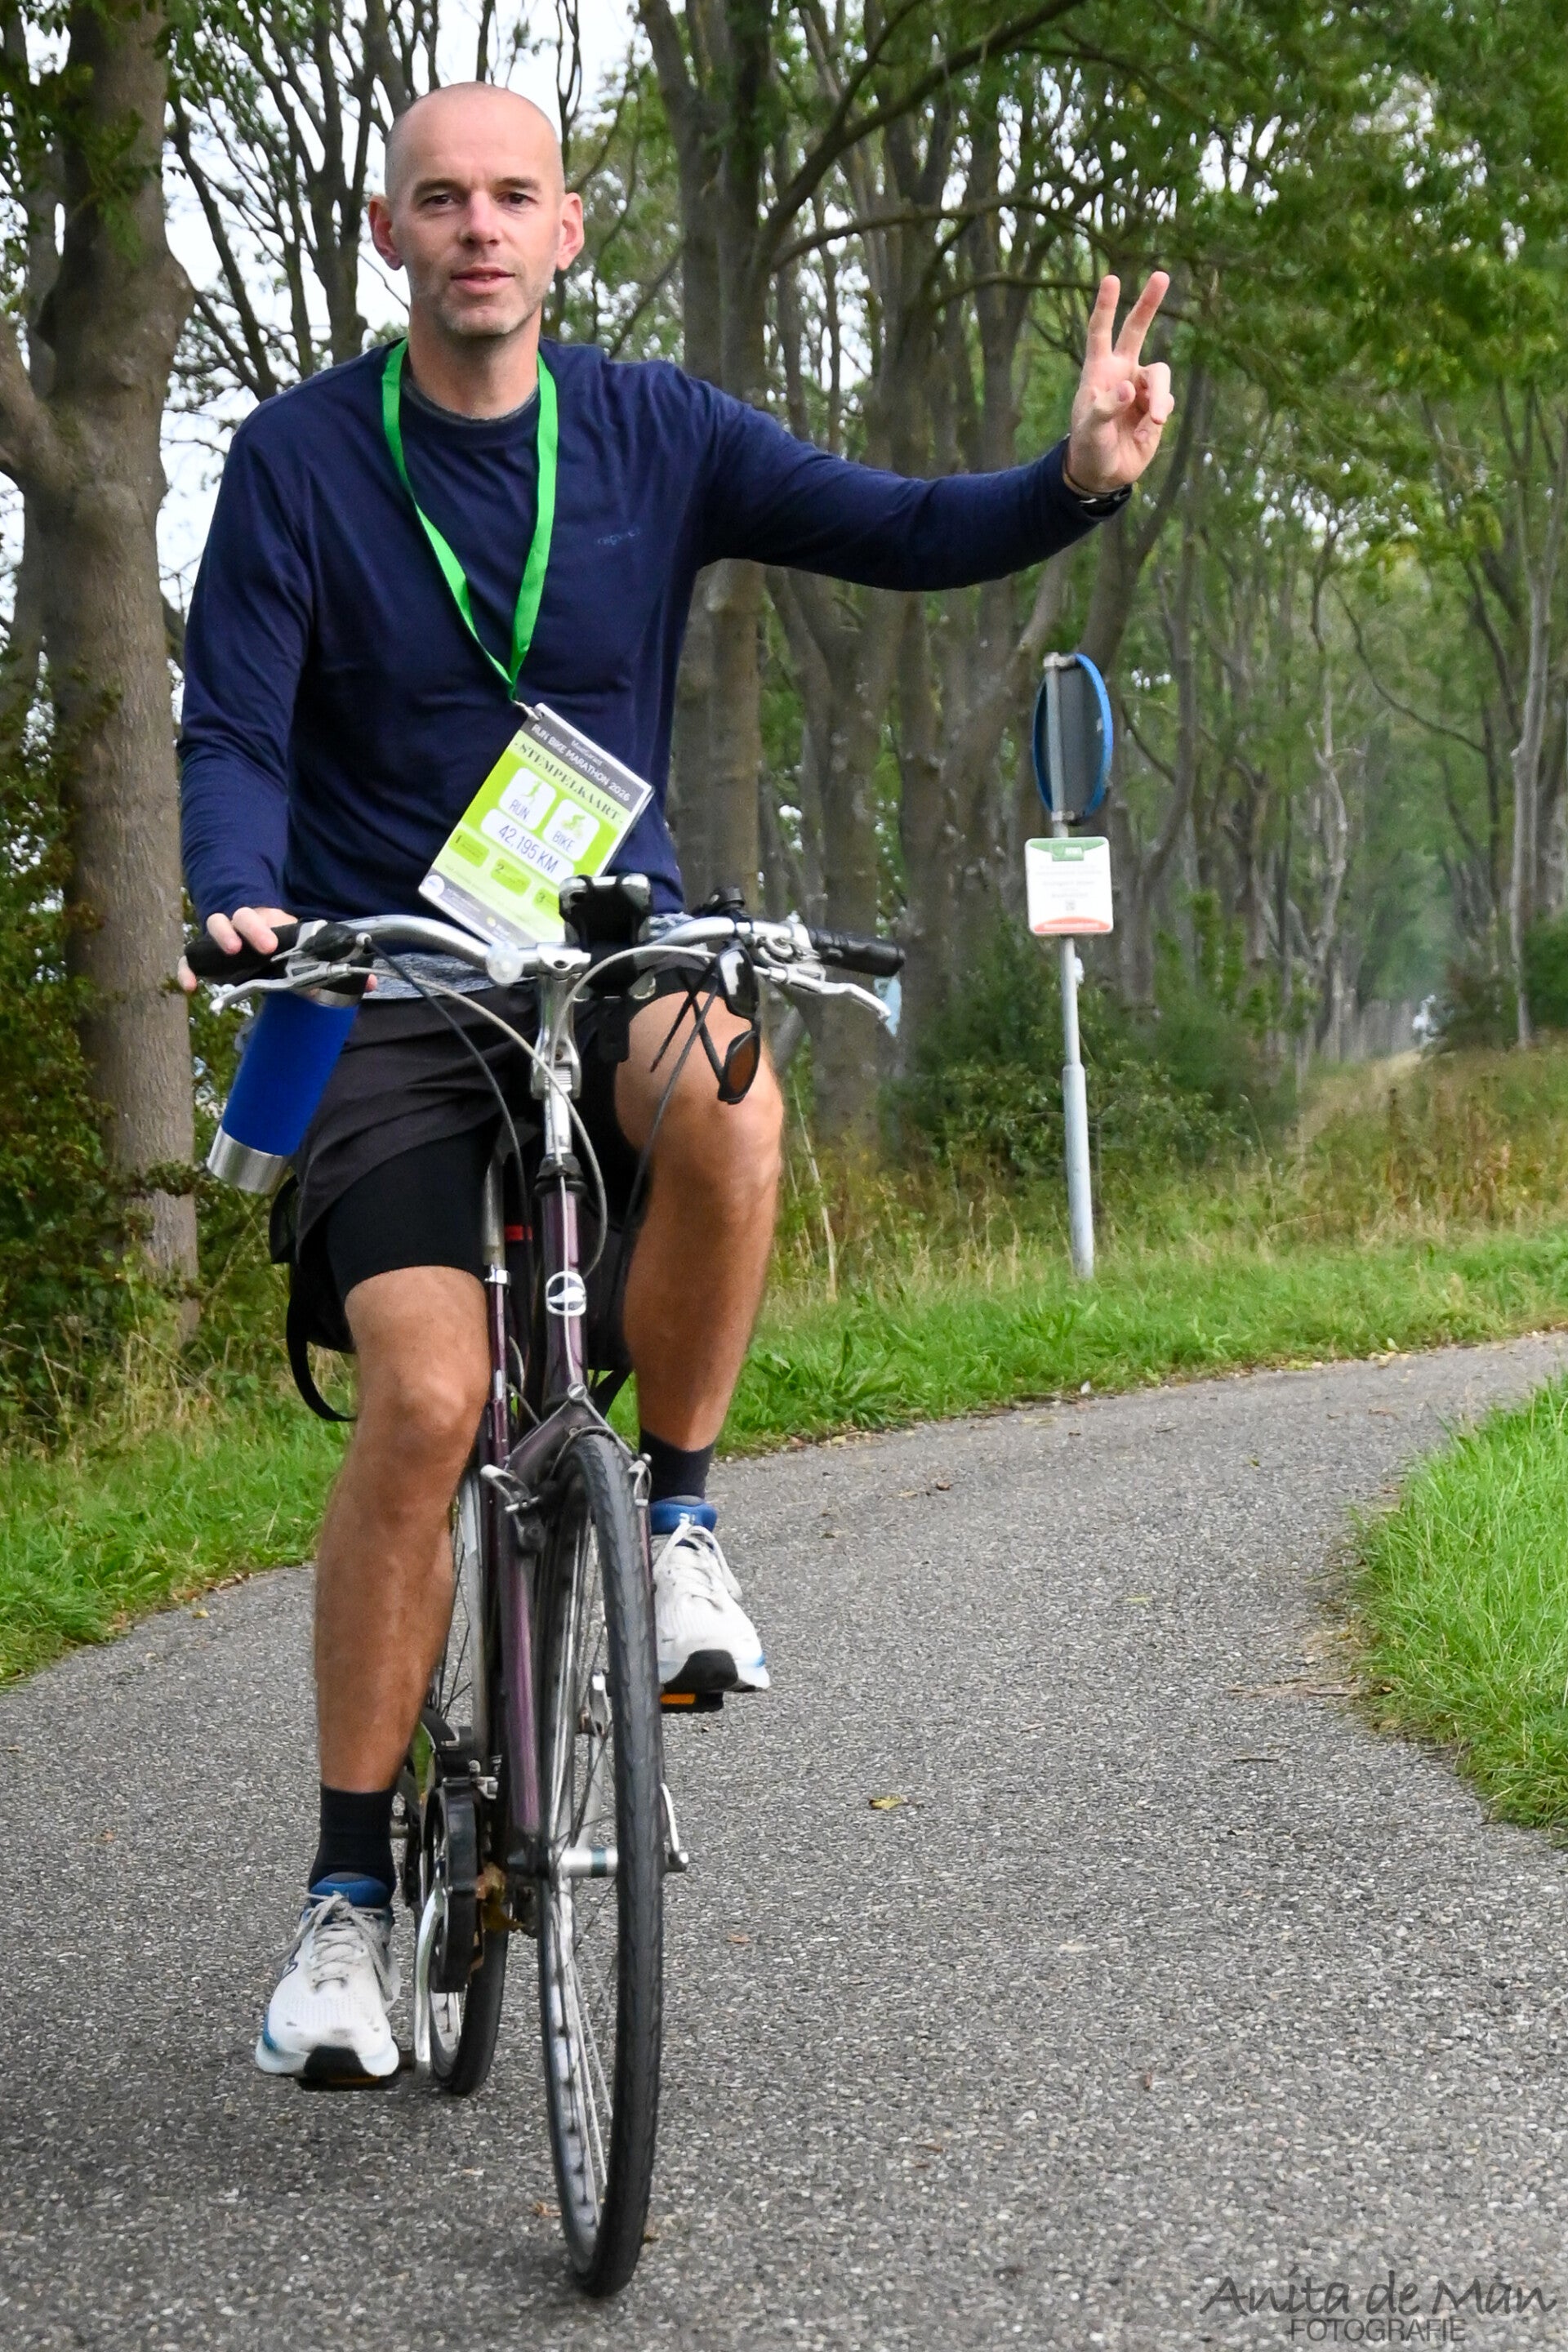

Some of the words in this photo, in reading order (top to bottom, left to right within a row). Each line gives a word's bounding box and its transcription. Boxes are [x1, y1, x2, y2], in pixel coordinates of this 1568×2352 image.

[532, 724, 550, 741] RUN
[548, 737, 568, 754] BIKE
[565, 749, 609, 786] MARATHON
[608, 782, 631, 801] 2026
[520, 743, 619, 820] STEMPELKAART
[509, 799, 530, 820] RUN
[498, 825, 539, 859] 42,195
[537, 851, 559, 874] KM
[552, 830, 575, 852] BIKE
[495, 862, 505, 874] 2
